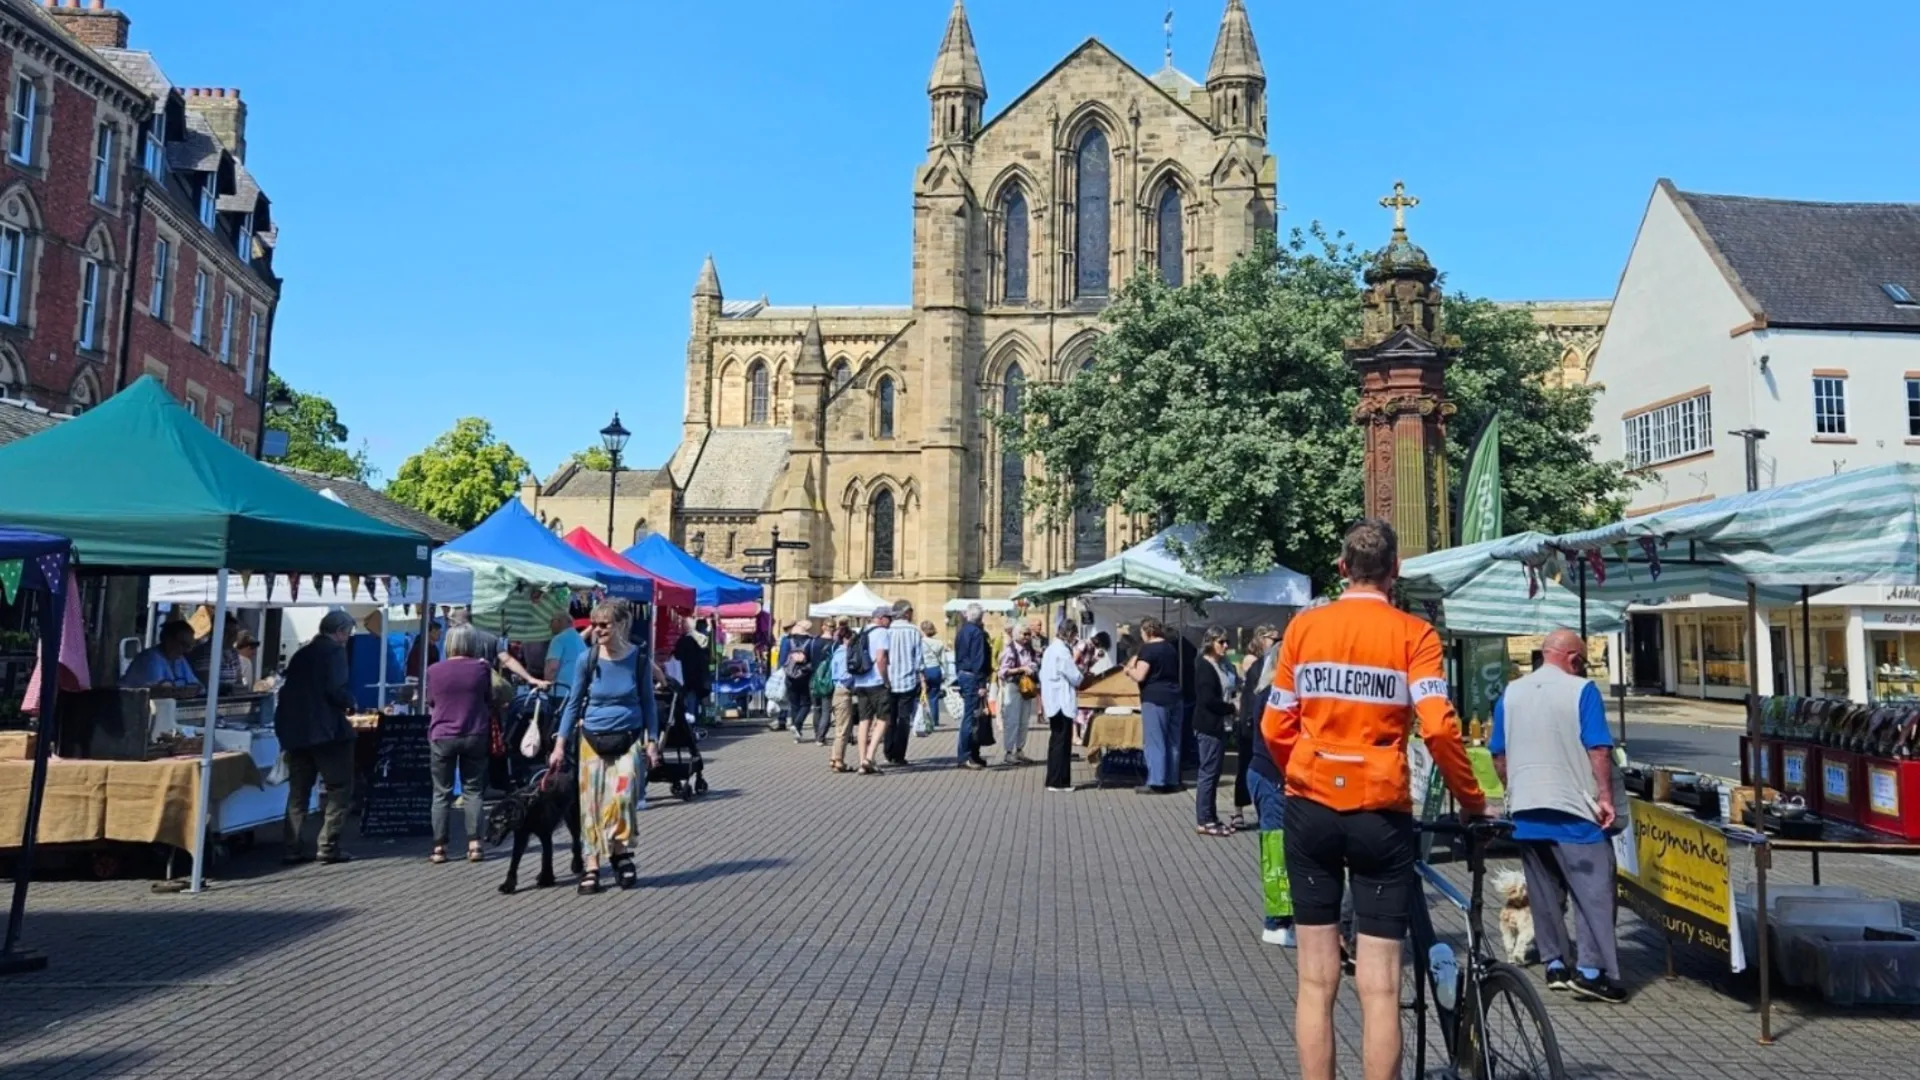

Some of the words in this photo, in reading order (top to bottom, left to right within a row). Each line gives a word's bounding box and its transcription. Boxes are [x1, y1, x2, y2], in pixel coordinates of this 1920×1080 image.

[1305, 667, 1396, 699] S.PELLEGRINO
[1663, 914, 1696, 944] curry
[1697, 928, 1730, 953] sauc
